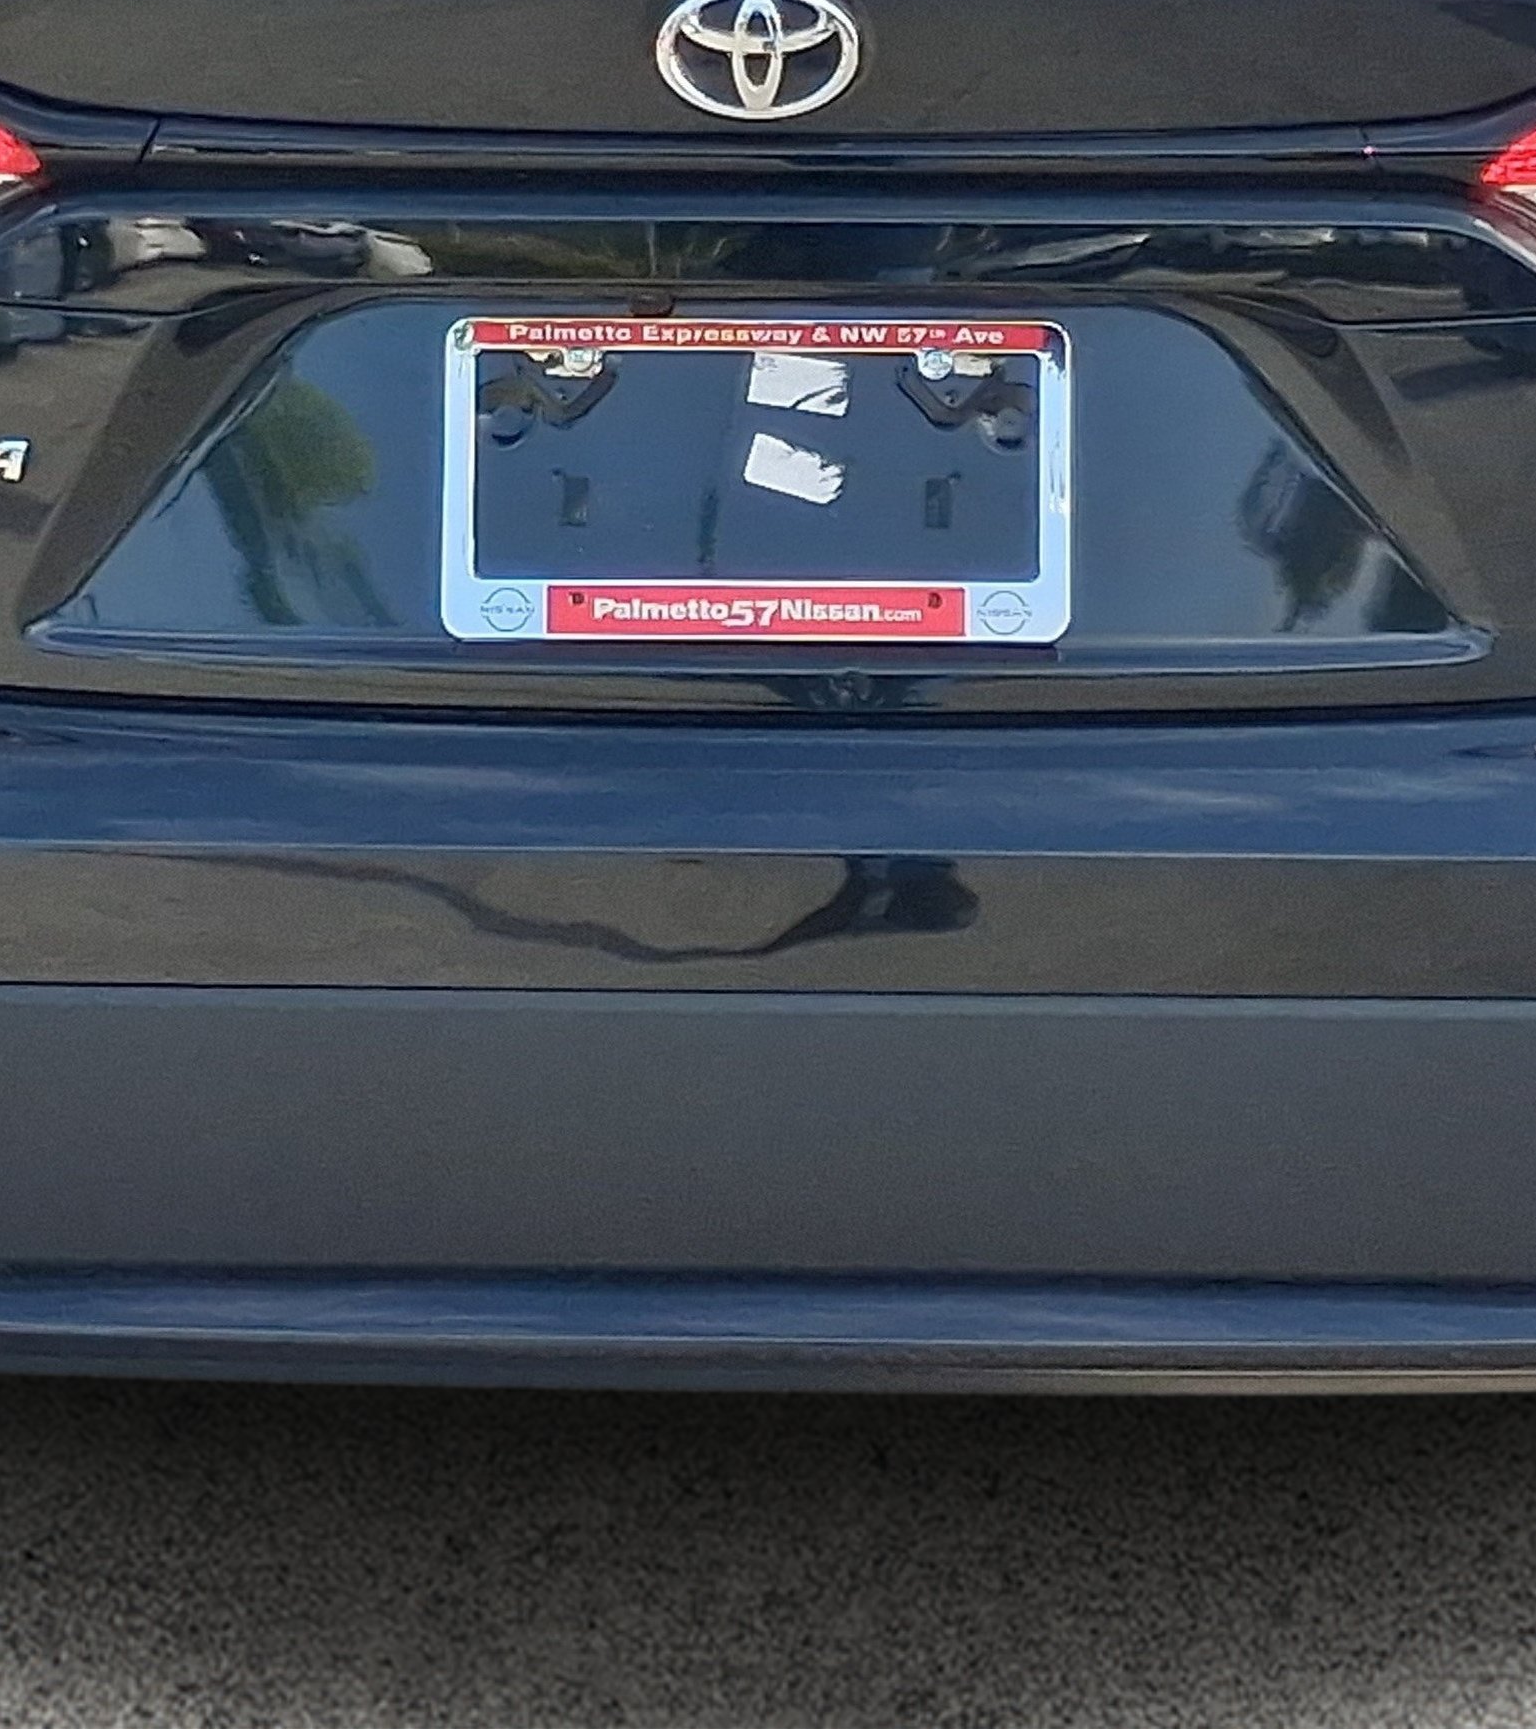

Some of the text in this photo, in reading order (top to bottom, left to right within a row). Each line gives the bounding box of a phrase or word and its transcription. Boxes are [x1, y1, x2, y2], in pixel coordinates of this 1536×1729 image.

[508, 323, 632, 342] Palmetto
[642, 325, 803, 346] Expressway
[812, 327, 831, 344] &
[840, 327, 888, 344] NW
[952, 328, 1005, 345] Ave
